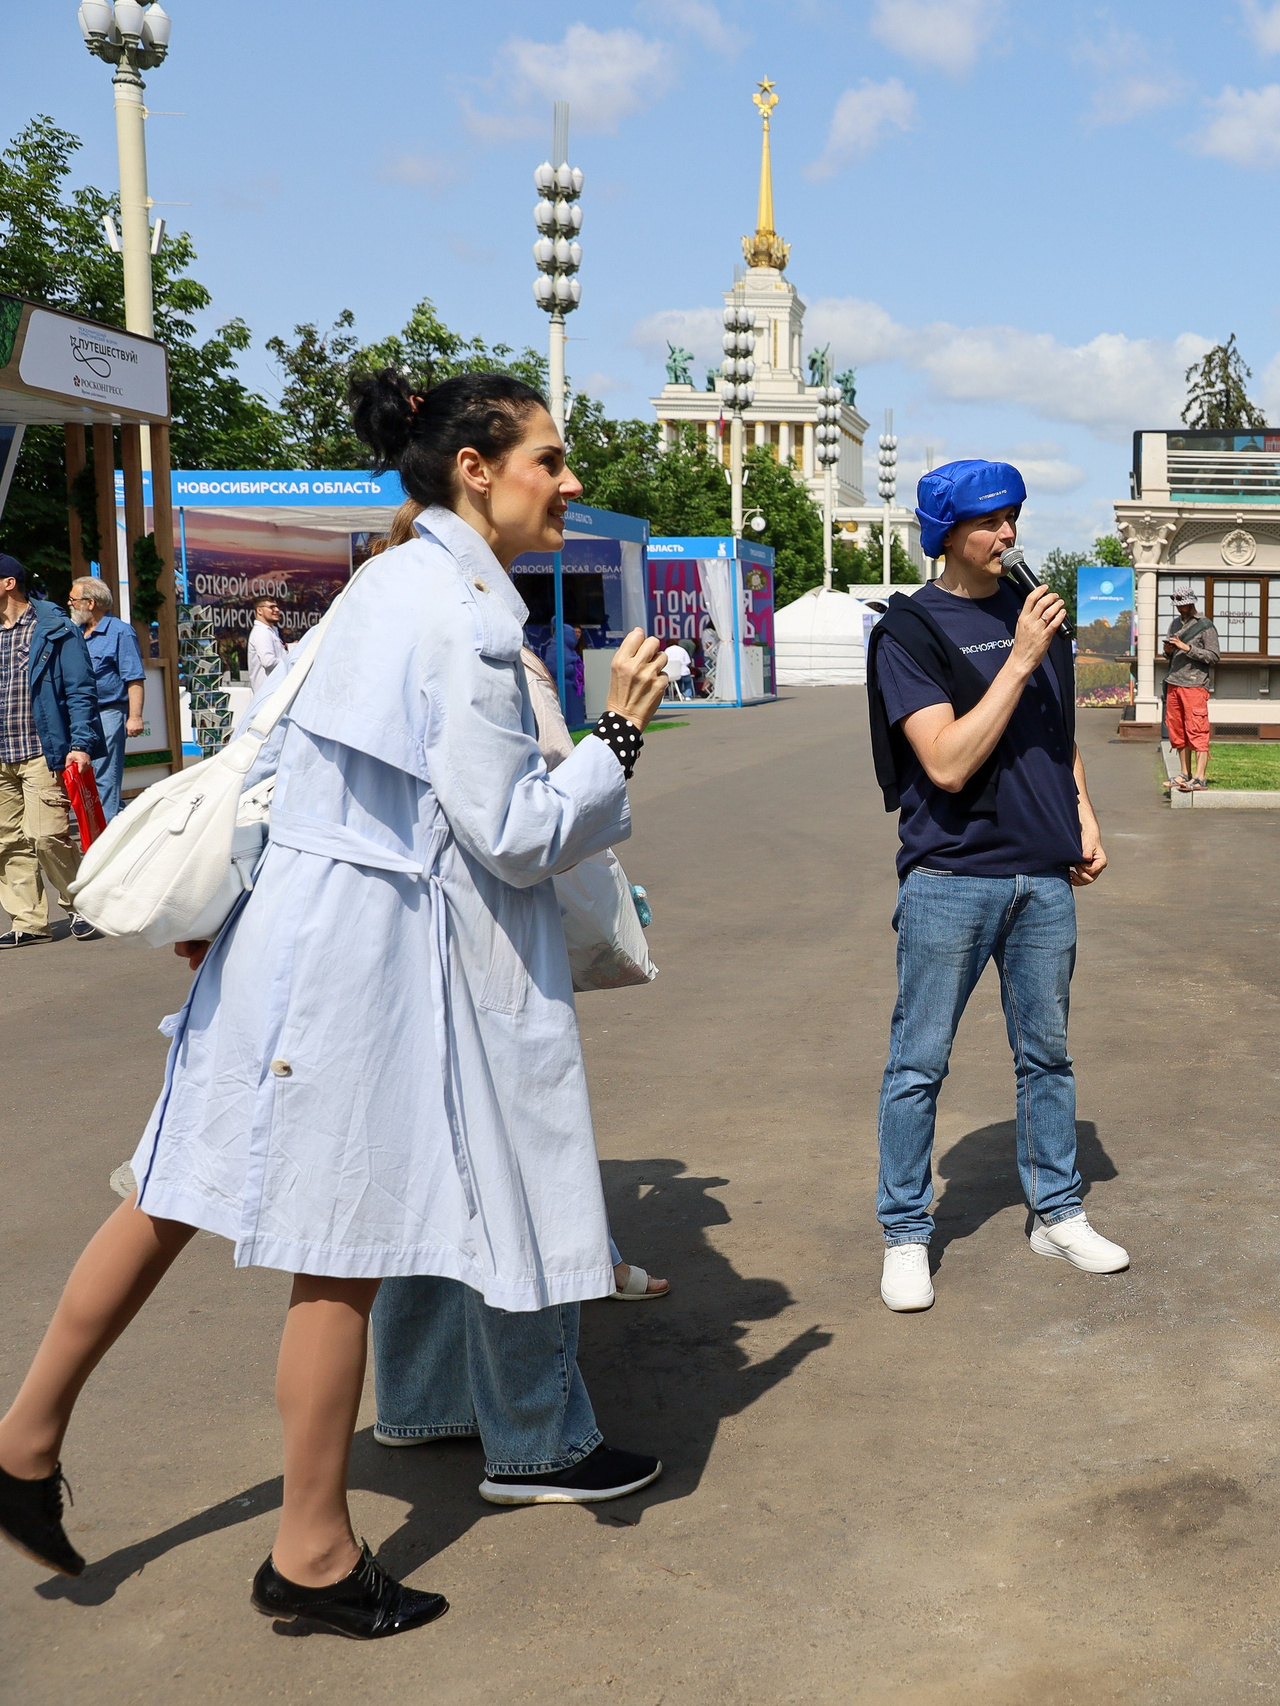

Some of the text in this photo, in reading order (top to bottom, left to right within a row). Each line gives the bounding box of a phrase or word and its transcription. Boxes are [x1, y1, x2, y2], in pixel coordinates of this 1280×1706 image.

[79, 338, 139, 364] ПУТЕШЕСТВУЙ!
[81, 378, 124, 396] РОСКОНГРЕСС
[177, 481, 381, 494] НОВОСИБИРСКАЯ ОБЛАСТЬ
[195, 572, 288, 599] ОТКРОЙ СВОЮ
